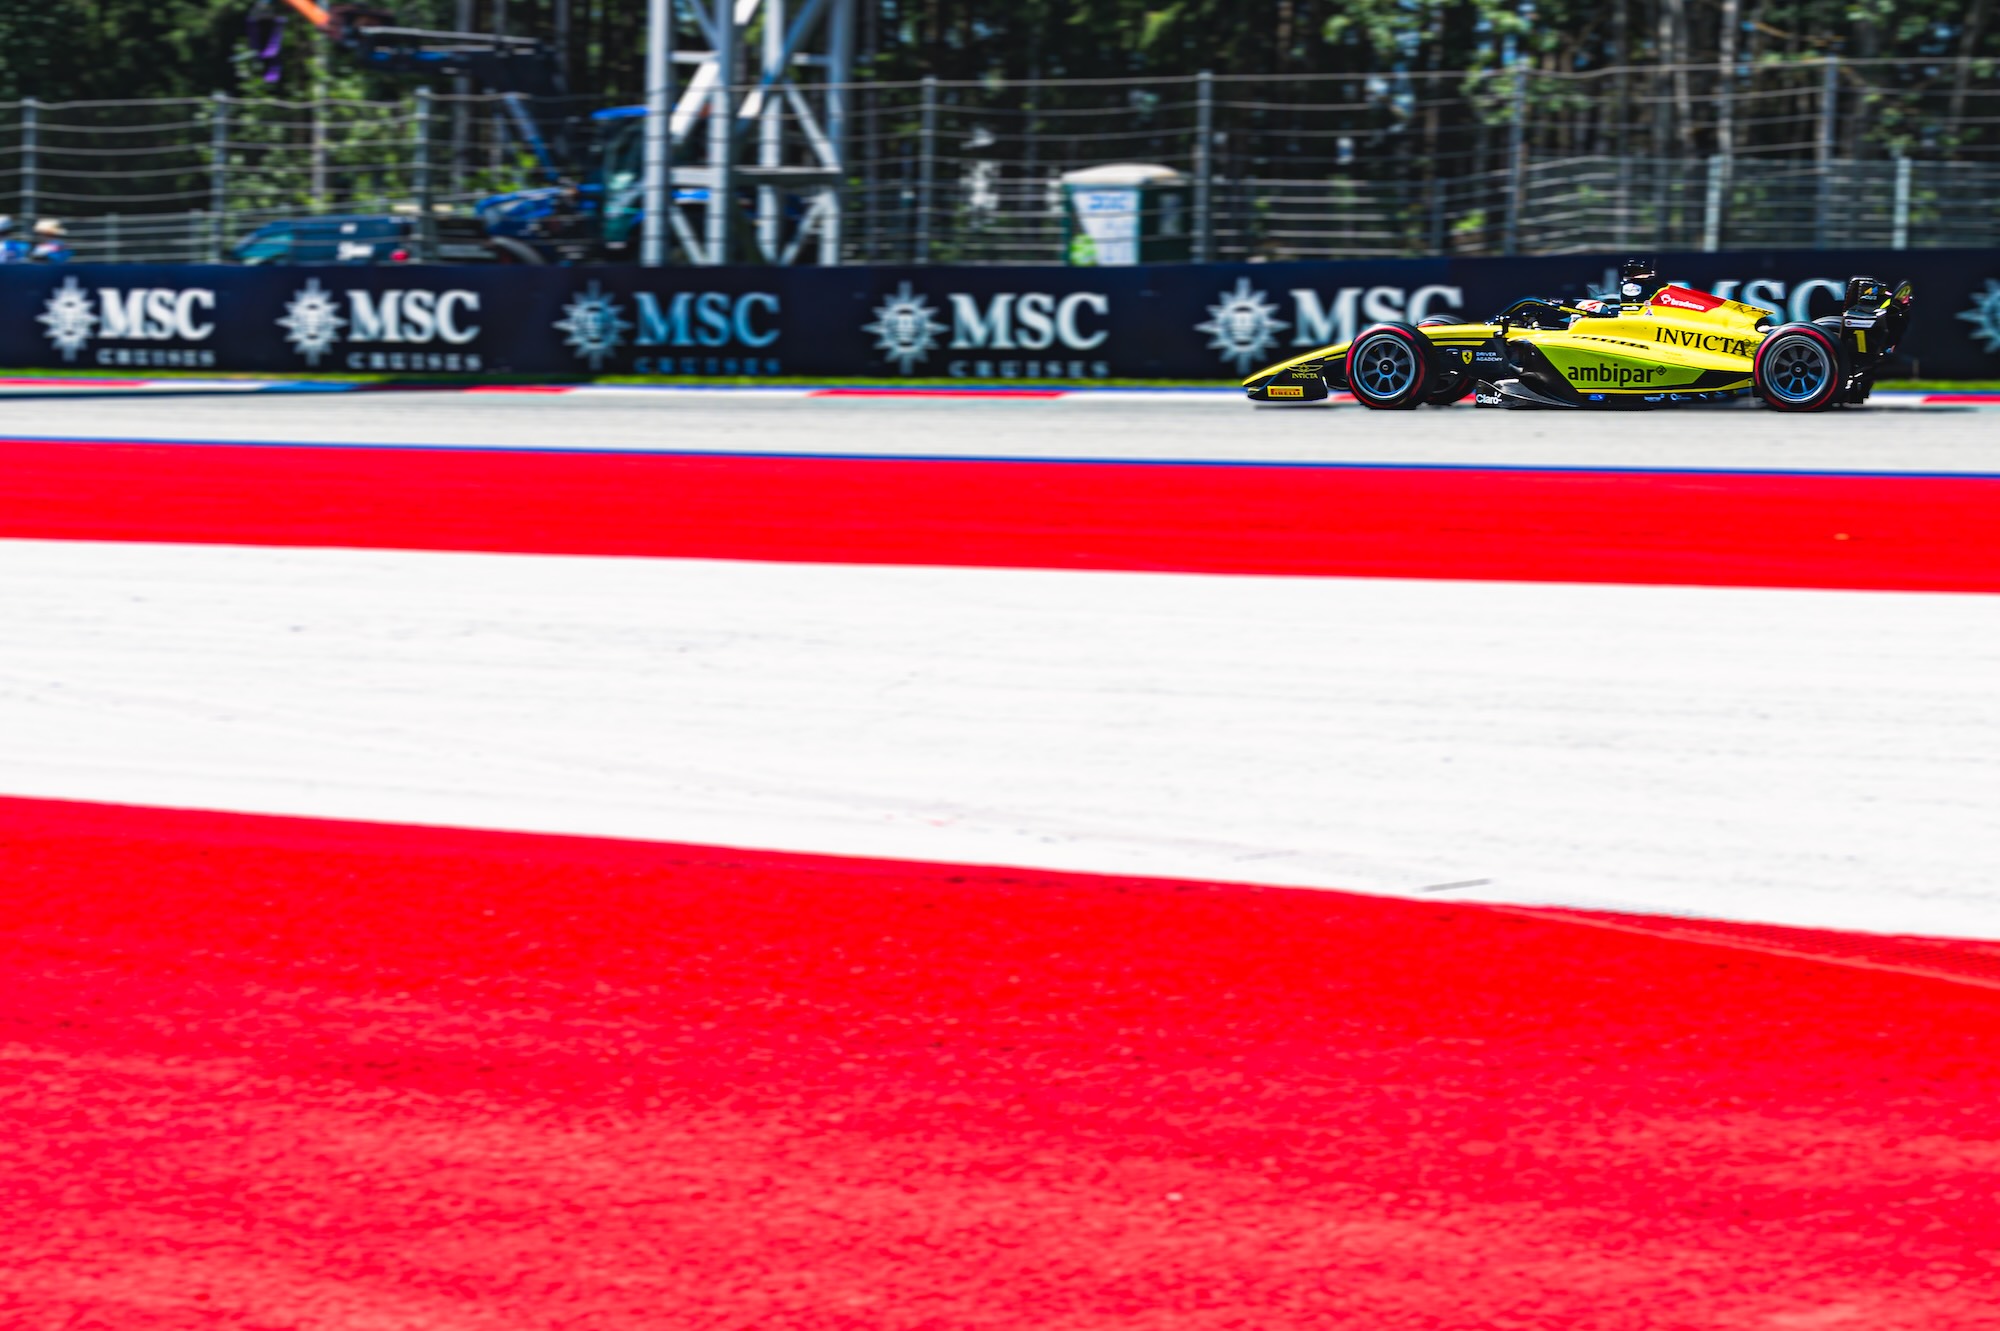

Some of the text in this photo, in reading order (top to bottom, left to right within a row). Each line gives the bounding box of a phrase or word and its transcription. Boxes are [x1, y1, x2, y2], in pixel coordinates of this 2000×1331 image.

[98, 287, 215, 340] MSC
[346, 289, 480, 343] MSC
[1667, 279, 1846, 326] SC
[1670, 298, 1705, 311] bradesco
[634, 292, 780, 347] MSC
[948, 292, 1109, 350] MSC
[1655, 326, 1747, 357] INVICTA
[1853, 329, 1867, 353] 1
[1567, 363, 1655, 387] ambipar
[1270, 388, 1301, 396] PIRELLI
[1476, 393, 1500, 405] Claro
